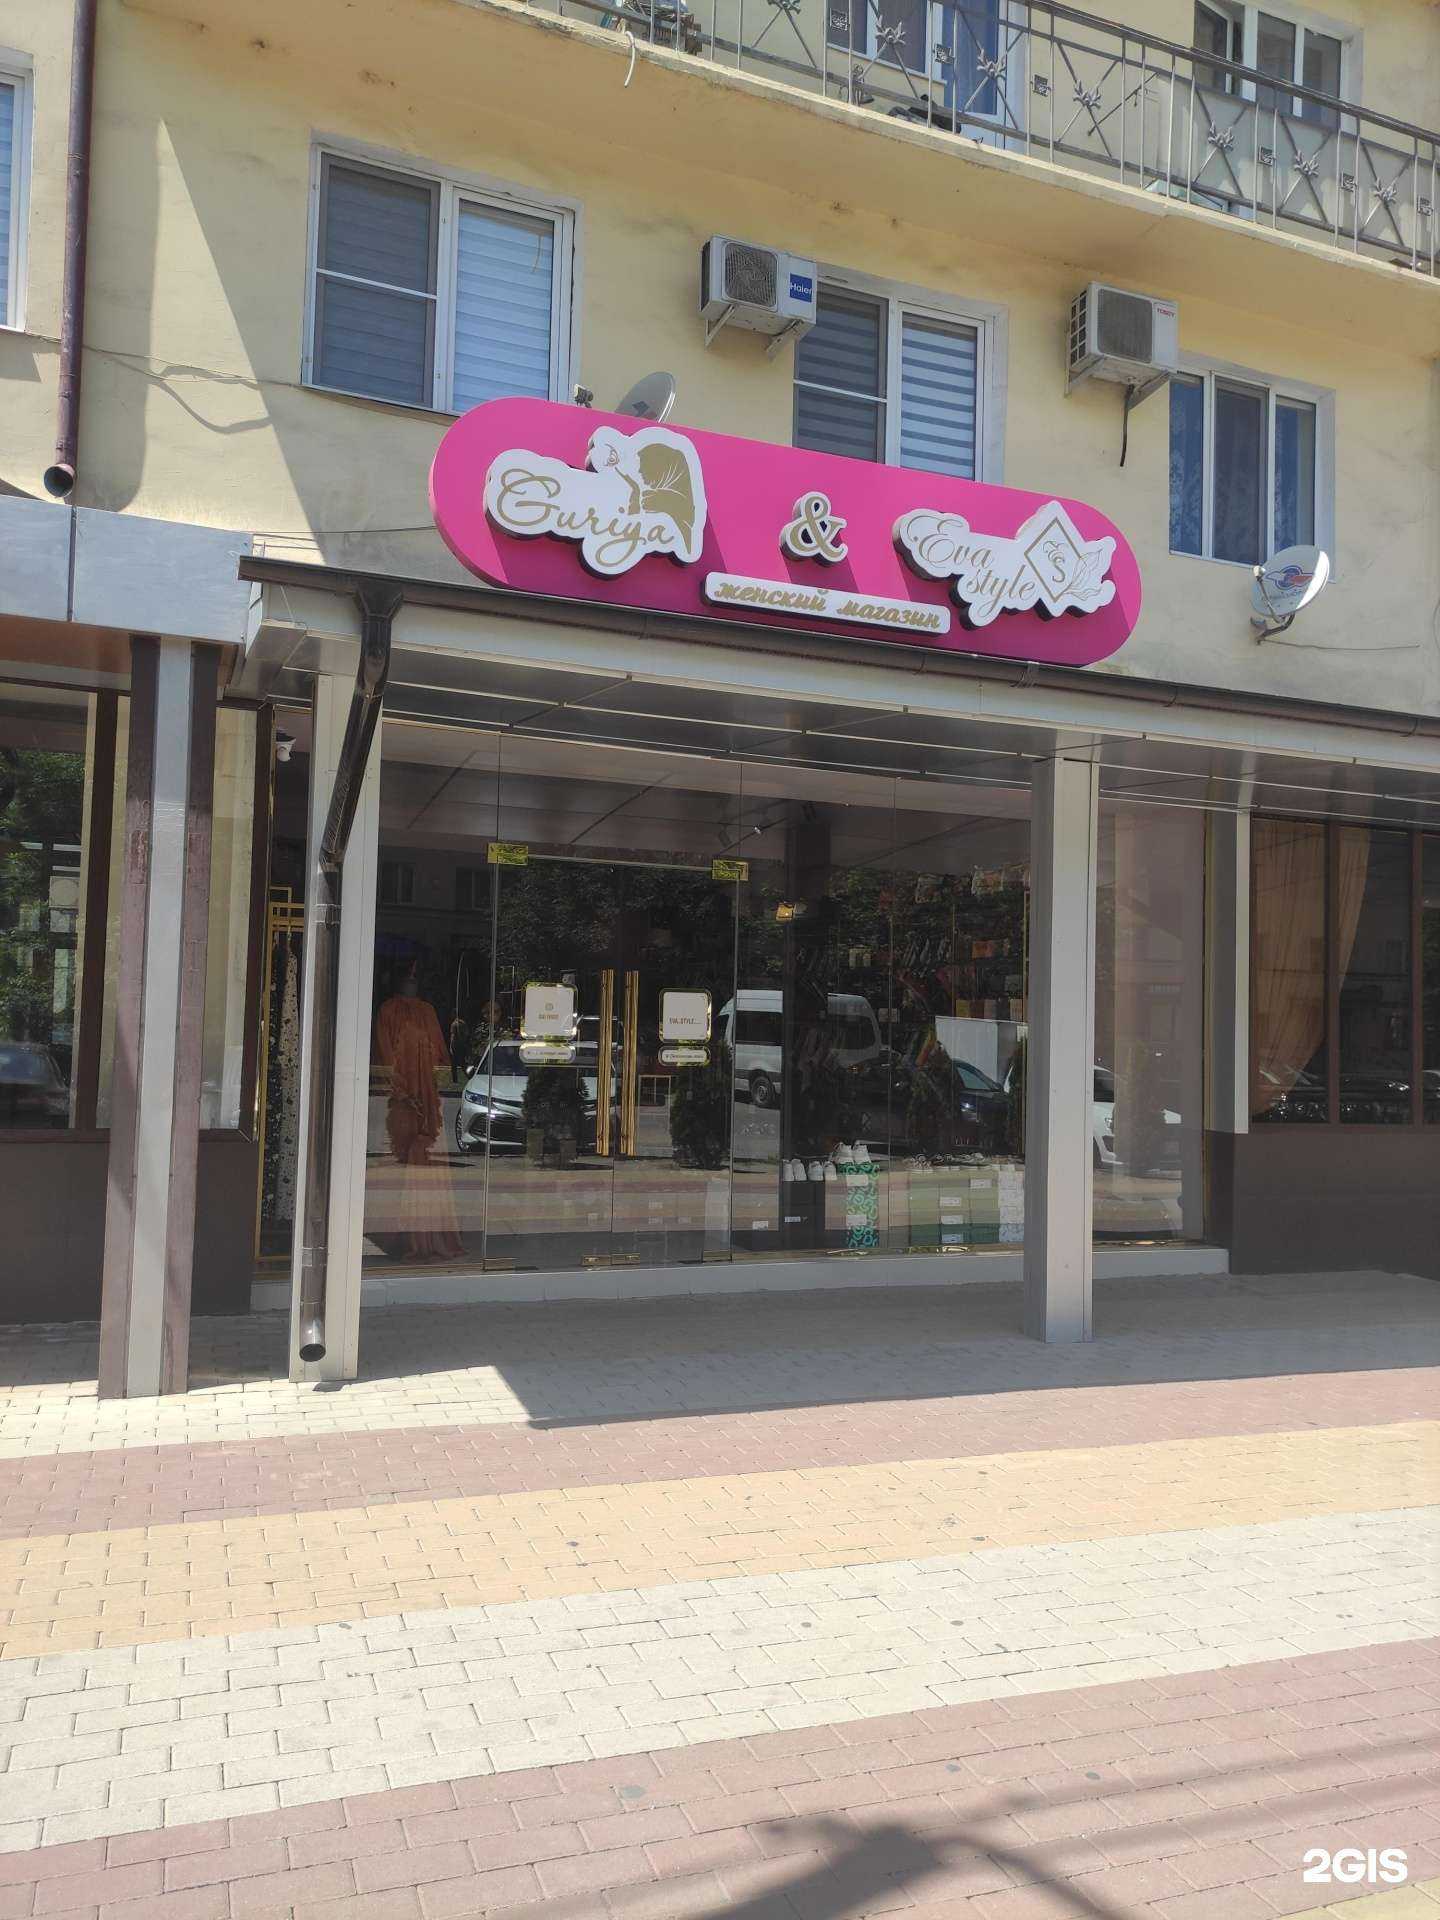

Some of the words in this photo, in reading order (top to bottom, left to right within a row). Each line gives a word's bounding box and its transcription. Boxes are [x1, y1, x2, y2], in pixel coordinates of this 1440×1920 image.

[789, 281, 813, 296] Haier
[496, 467, 675, 568] Guriya
[789, 496, 845, 559] &
[906, 514, 995, 565] Eva
[714, 582, 827, 612] женский
[836, 599, 941, 629] магазин
